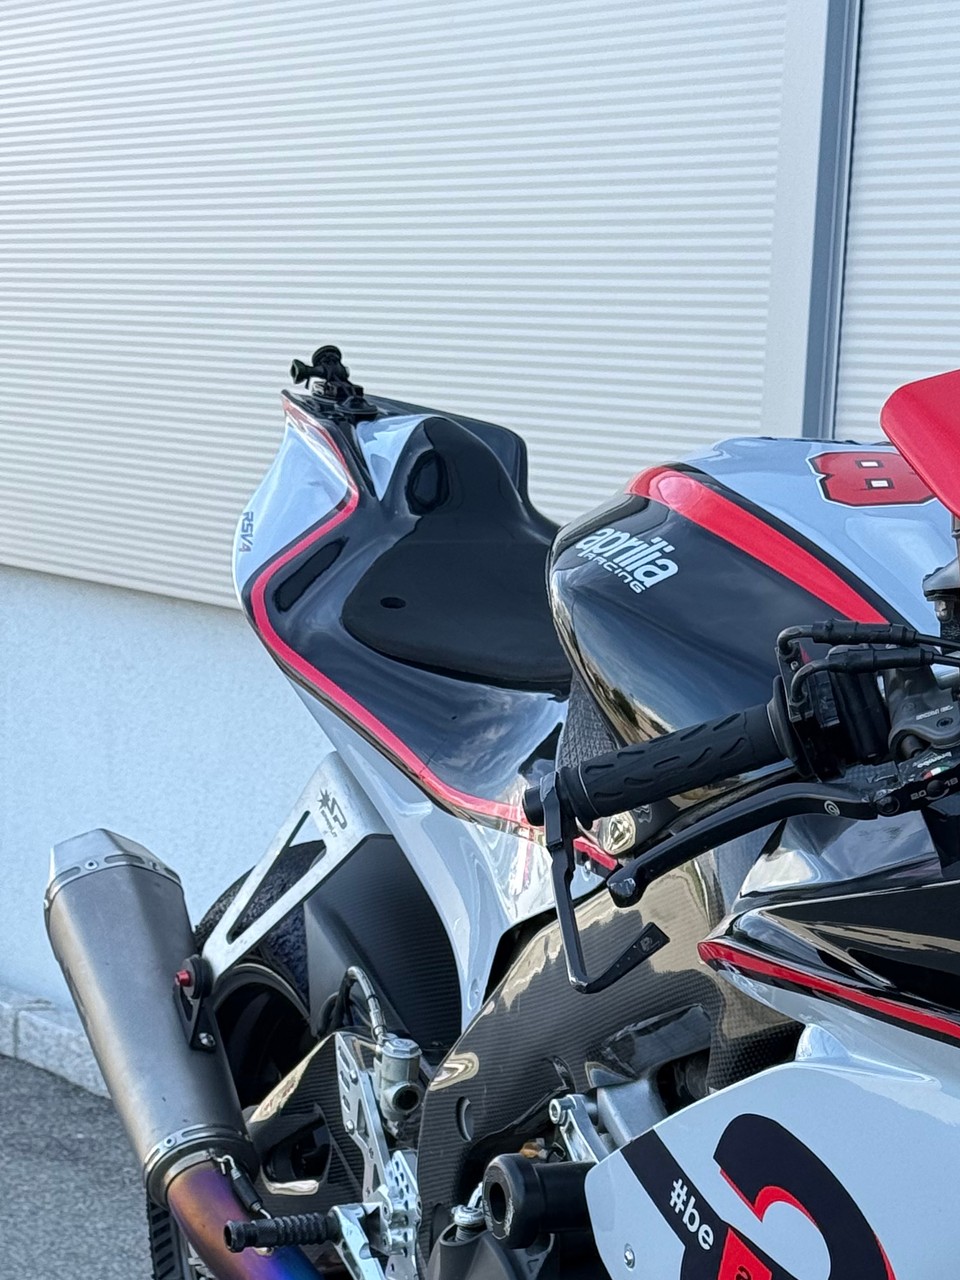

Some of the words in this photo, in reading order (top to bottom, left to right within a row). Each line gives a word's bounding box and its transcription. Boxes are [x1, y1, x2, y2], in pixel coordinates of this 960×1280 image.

[239, 511, 254, 552] RSV4
[575, 528, 679, 589] aprilia
[669, 1178, 714, 1250] #be
